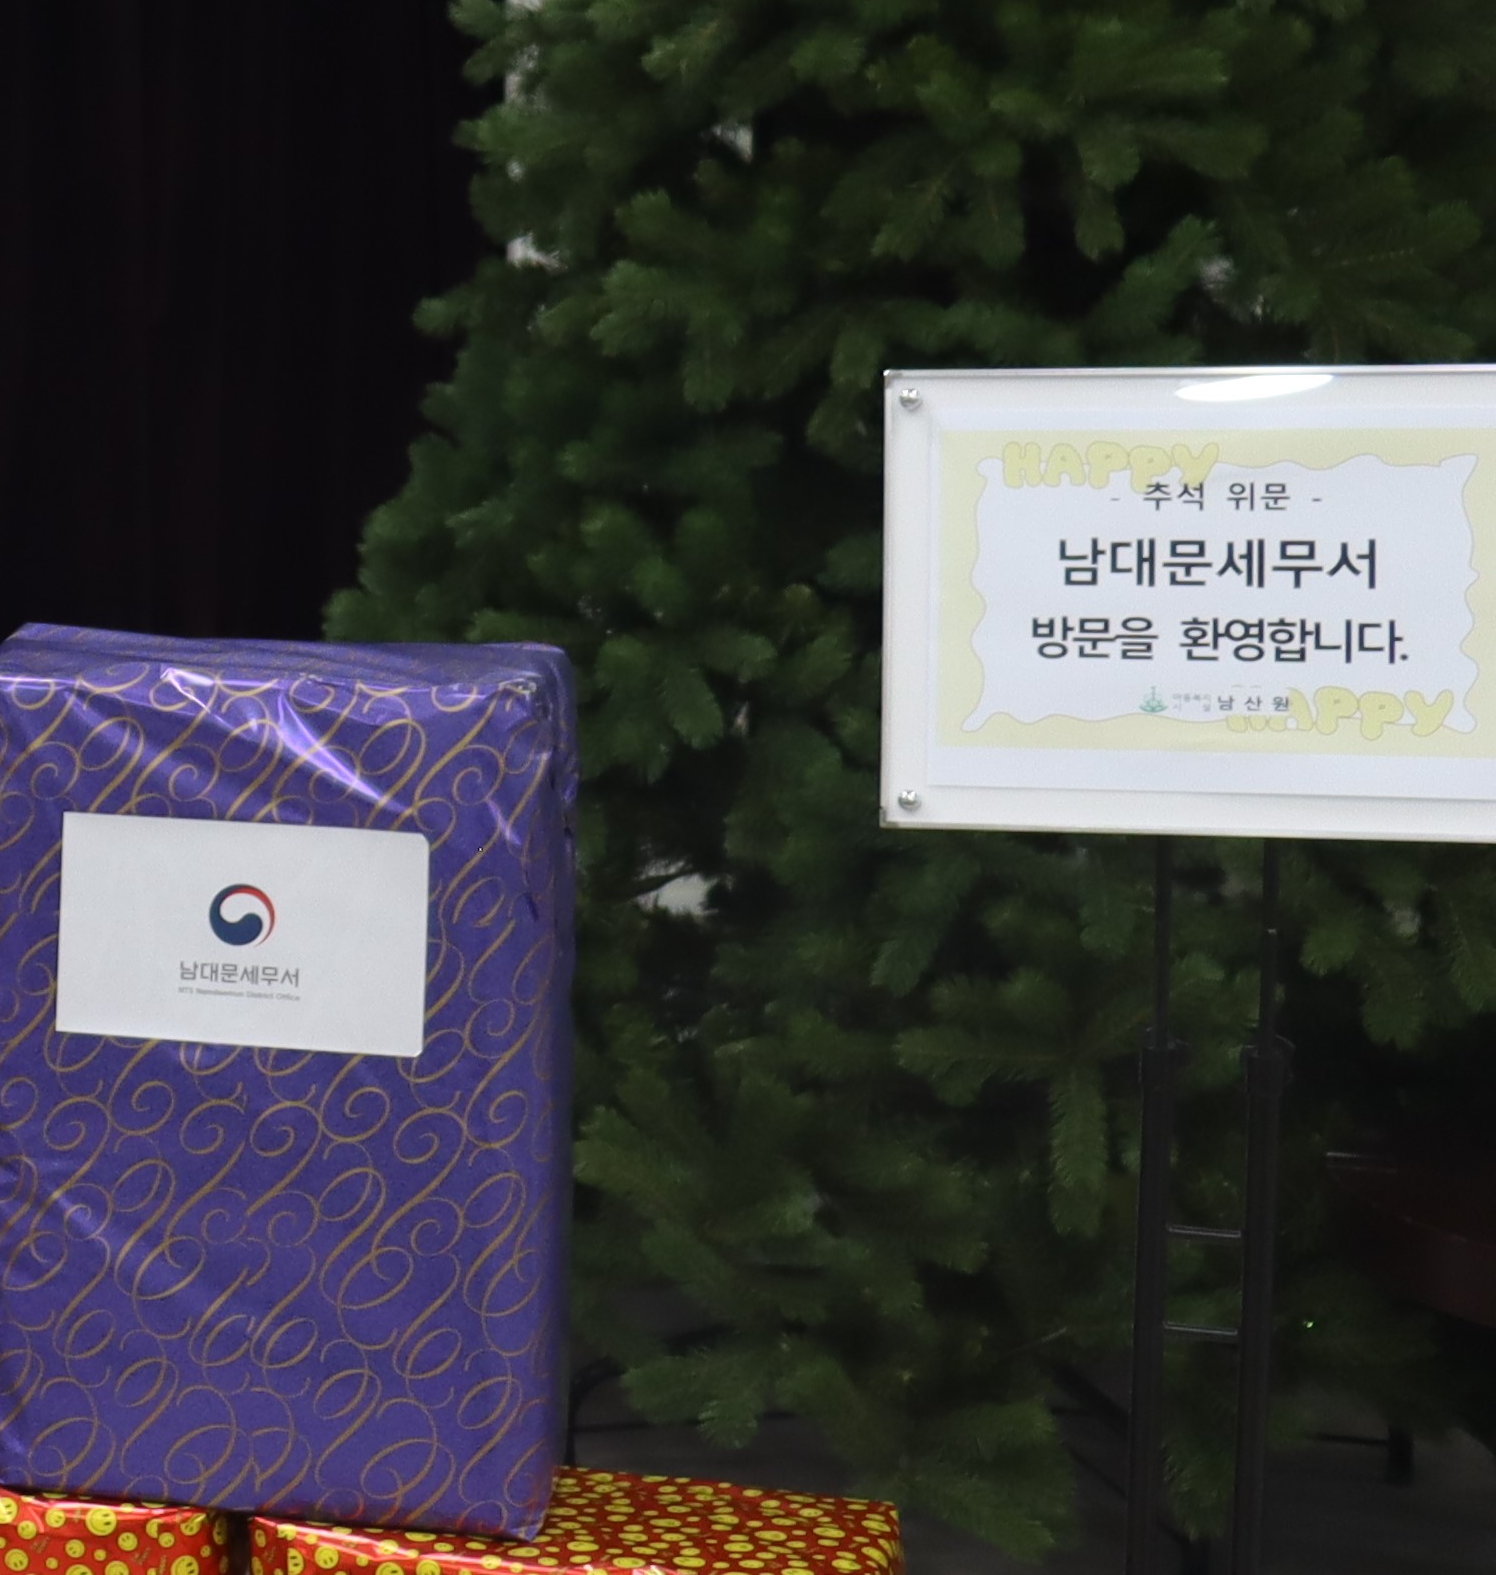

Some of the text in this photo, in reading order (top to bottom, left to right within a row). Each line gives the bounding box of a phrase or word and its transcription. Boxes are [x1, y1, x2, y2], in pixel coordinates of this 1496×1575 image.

[1003, 441, 1219, 493] HAPPY
[1144, 481, 1204, 510] 추석
[1228, 483, 1289, 511] 위문
[1060, 538, 1375, 589] 남대문세무서
[1033, 616, 1408, 664] 방문을 환영합니다.
[1225, 686, 1453, 740] APPY
[180, 962, 299, 987] 남대문세무서
